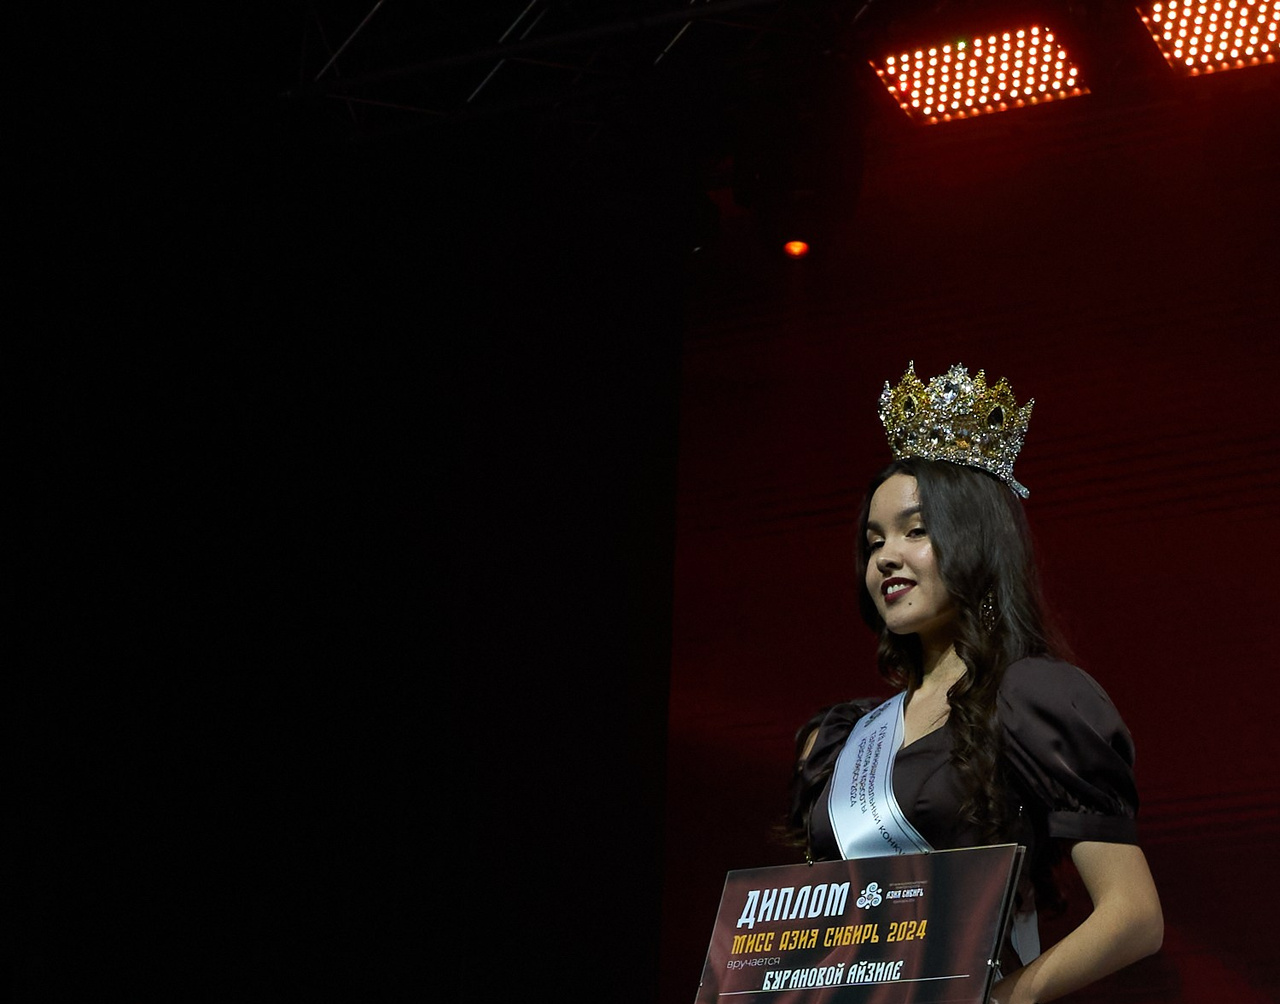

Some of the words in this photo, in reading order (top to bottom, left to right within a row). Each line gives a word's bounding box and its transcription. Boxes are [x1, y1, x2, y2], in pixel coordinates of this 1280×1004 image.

[736, 881, 851, 929] ДИПЛОМ
[731, 933, 775, 955] МИСС
[779, 929, 819, 951] АЗИЯ
[823, 924, 880, 947] СИБИРЬ
[886, 919, 927, 942] 2024
[727, 956, 781, 970] вручается
[762, 961, 846, 991] БУРАНОВОЙ
[846, 959, 904, 983] АЙЗИЛЕ
